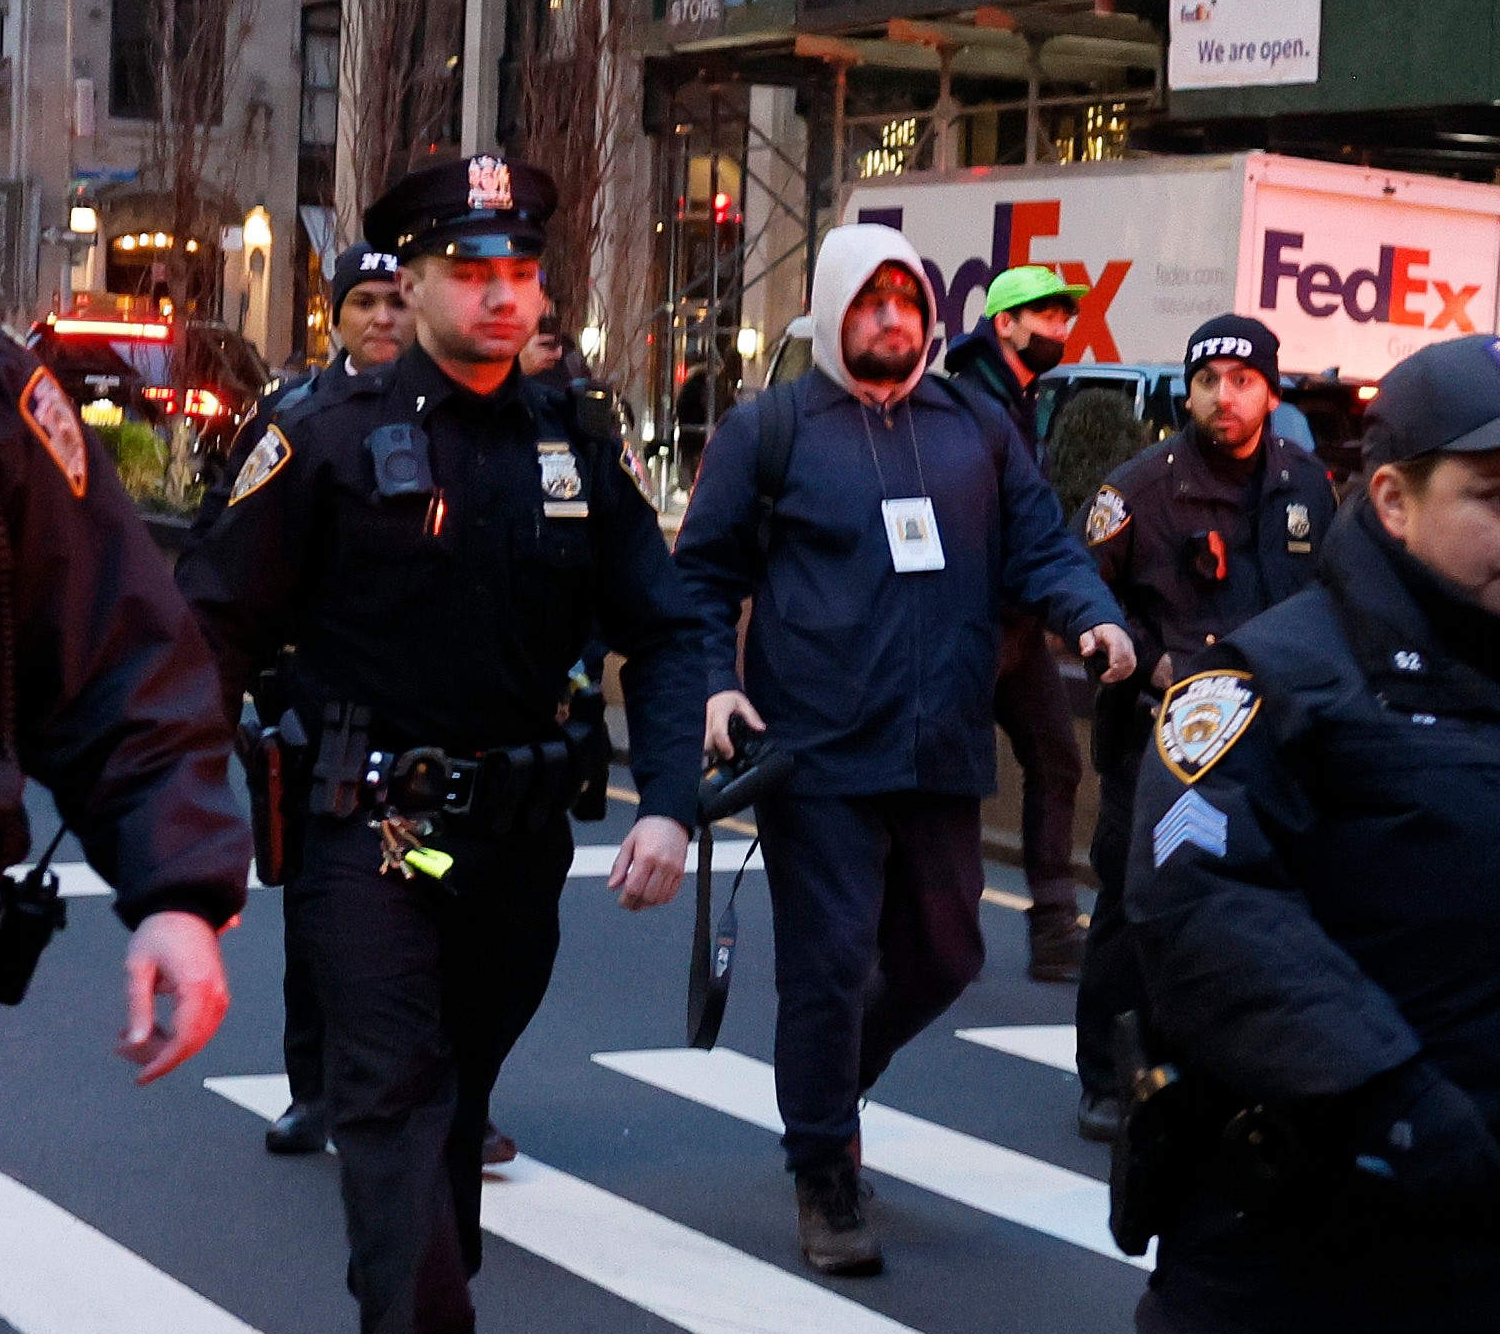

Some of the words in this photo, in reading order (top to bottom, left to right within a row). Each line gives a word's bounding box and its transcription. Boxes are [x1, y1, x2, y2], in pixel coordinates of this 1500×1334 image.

[1198, 39, 1225, 64] We
[1229, 42, 1257, 63] are
[1259, 36, 1311, 68] open.
[1260, 229, 1482, 333] FedEx
[1190, 336, 1253, 363] NYPD
